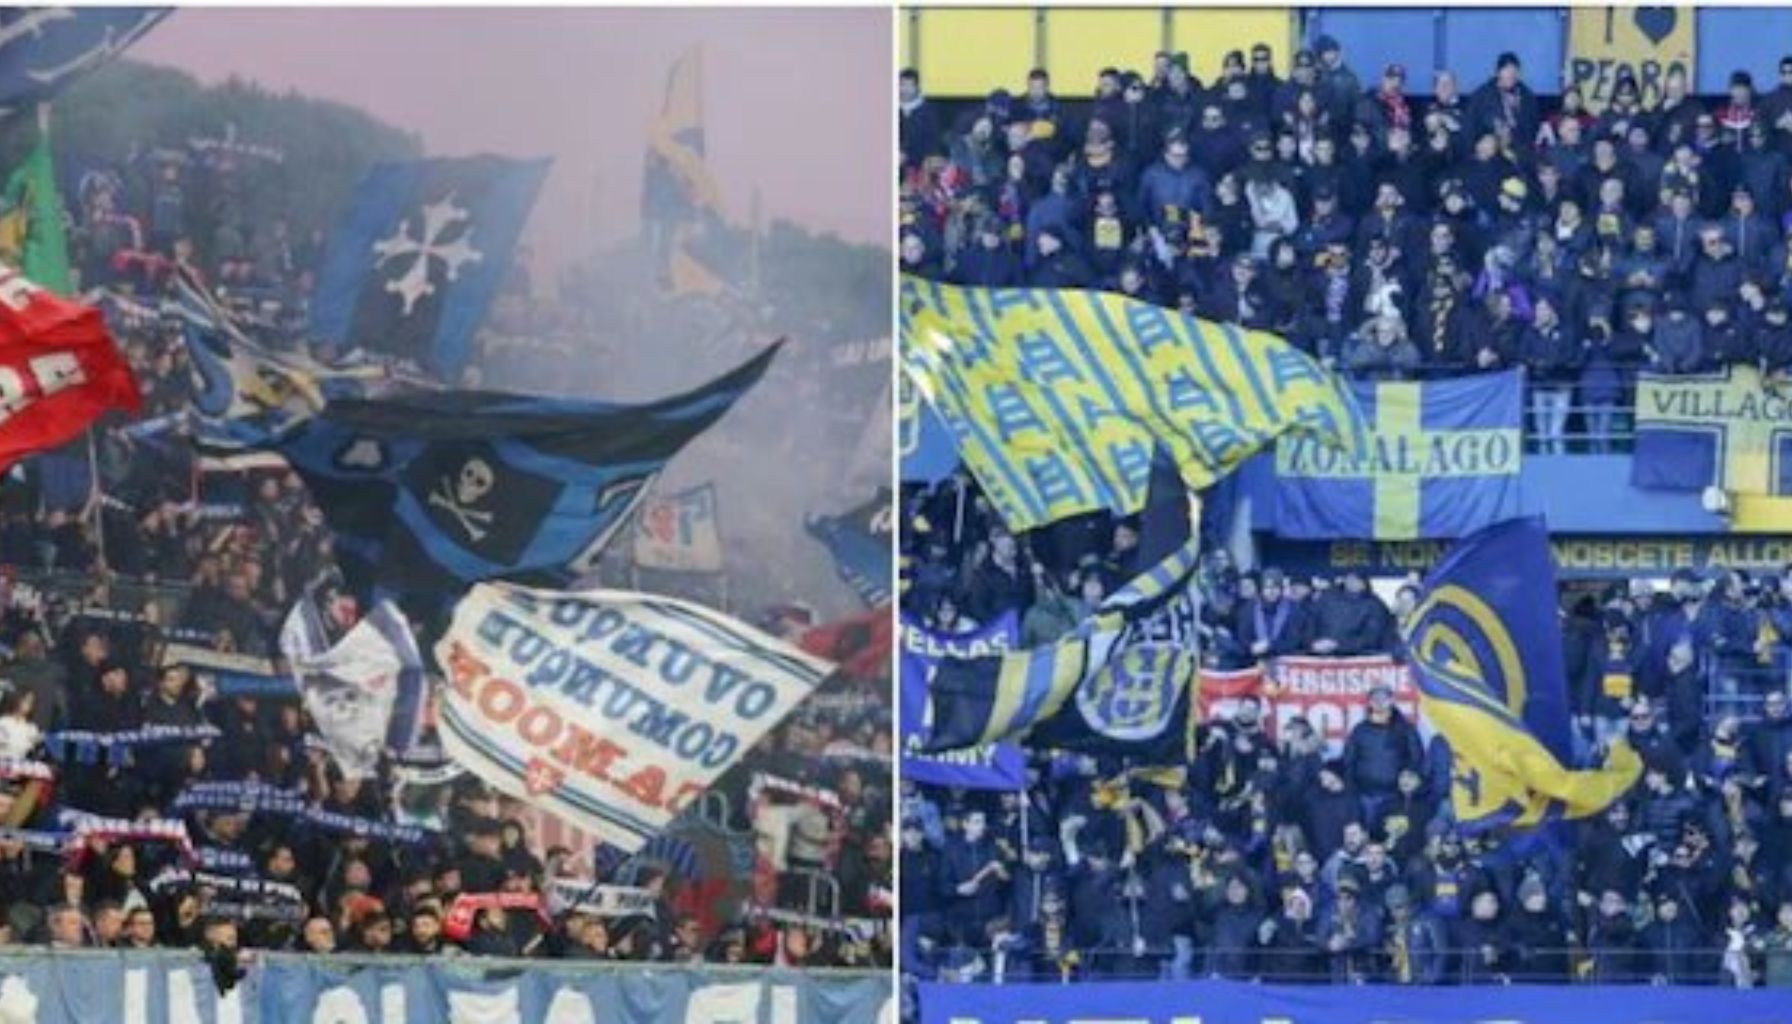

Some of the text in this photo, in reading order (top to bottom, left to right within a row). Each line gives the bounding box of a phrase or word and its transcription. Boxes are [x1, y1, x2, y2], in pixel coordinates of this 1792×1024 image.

[1651, 389, 1792, 421] VILLAG
[1551, 541, 1693, 569] NOSCETE
[900, 624, 1011, 658] ELLAS
